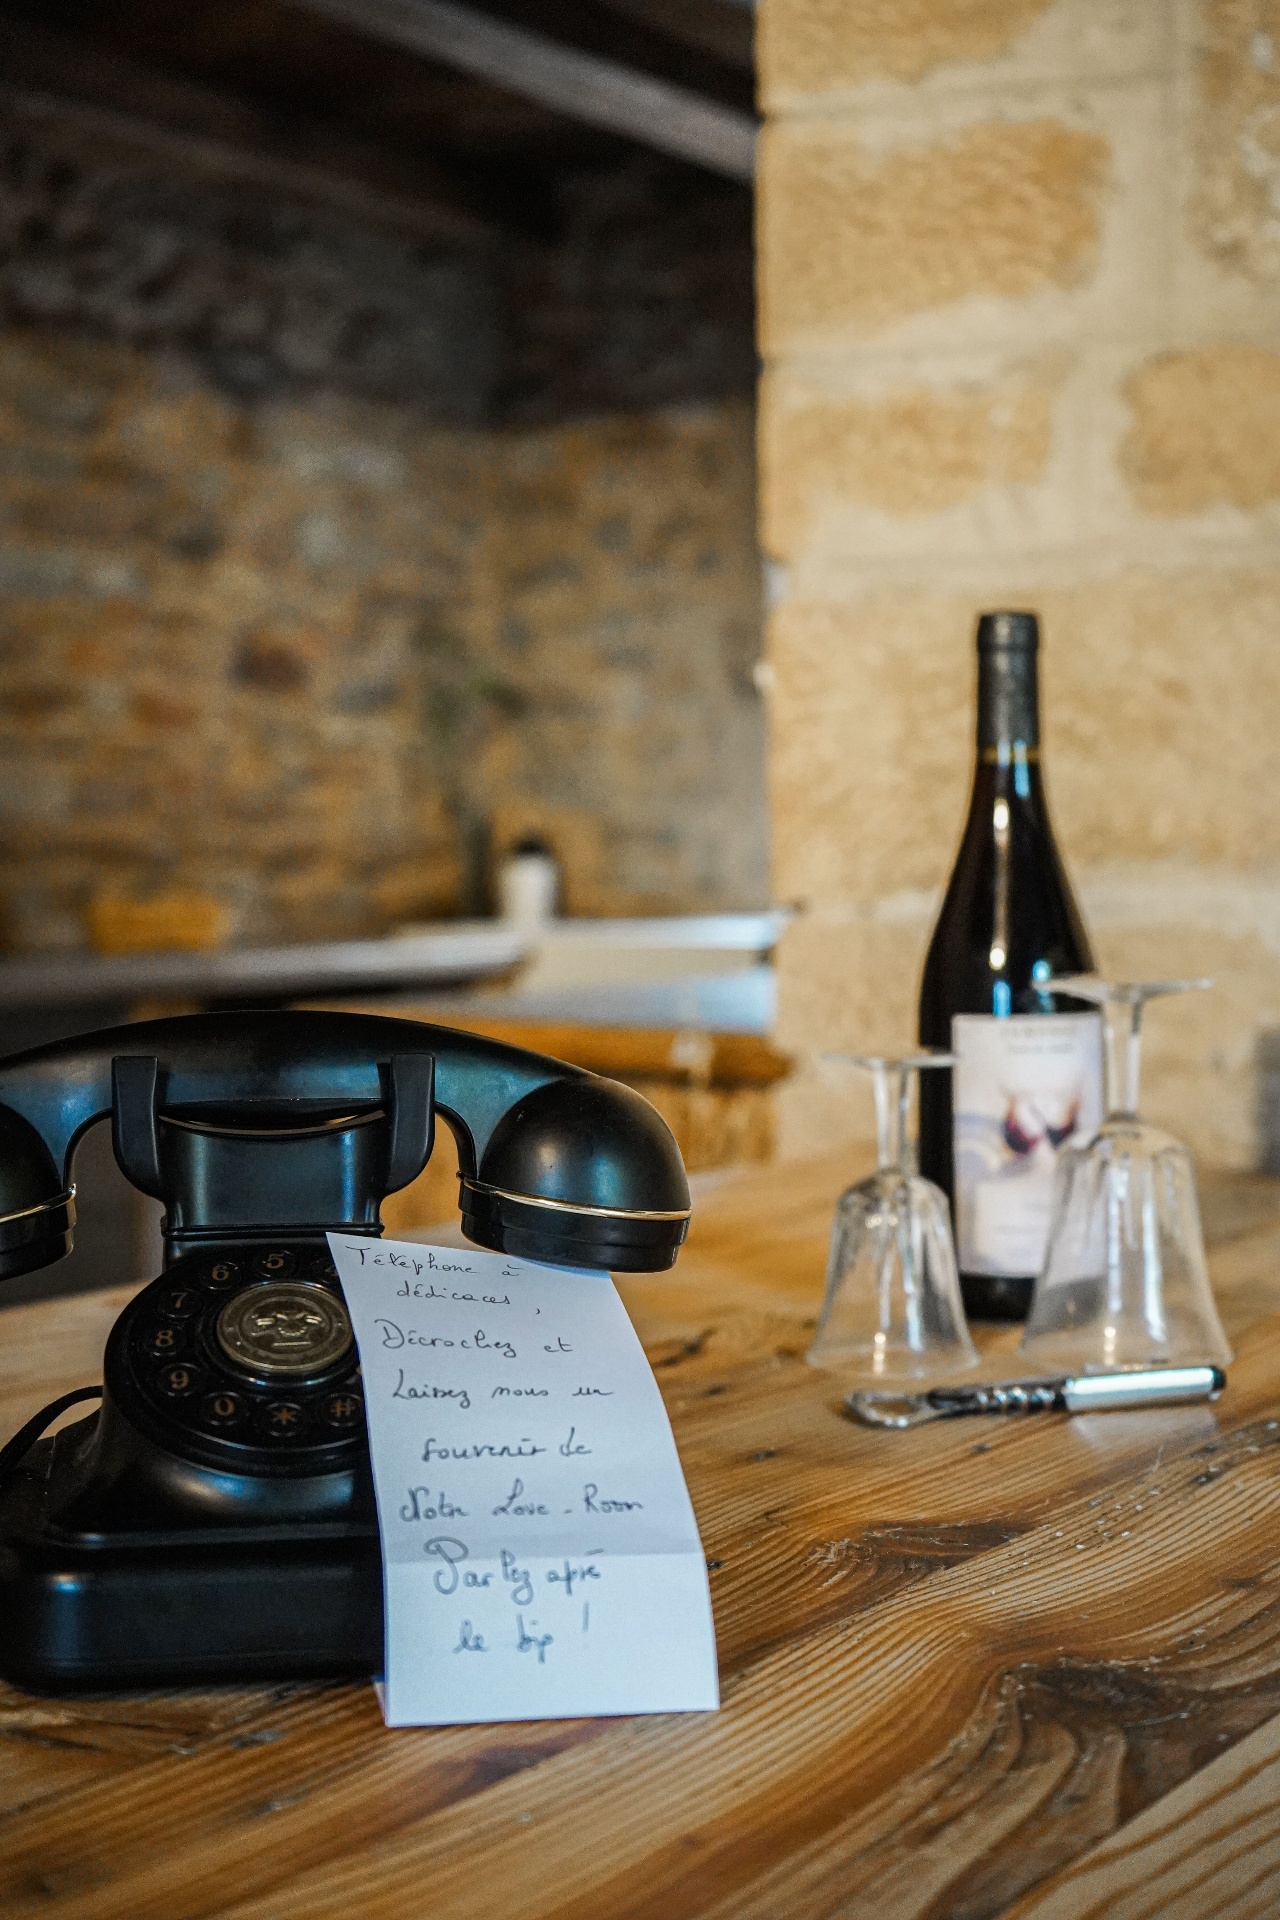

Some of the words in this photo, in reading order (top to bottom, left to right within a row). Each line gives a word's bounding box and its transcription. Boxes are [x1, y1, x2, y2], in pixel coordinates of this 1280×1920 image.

[265, 1253, 284, 1269] 5
[211, 1266, 230, 1281] 6
[171, 1292, 187, 1308] 7
[155, 1331, 174, 1348] 8
[374, 1319, 517, 1358] Décrochez
[544, 1337, 573, 1352] et
[170, 1371, 189, 1389] 9
[491, 1386, 549, 1399] nous
[572, 1388, 614, 1396] un
[215, 1399, 235, 1416] 0
[559, 1427, 592, 1455] de
[492, 1478, 549, 1516] Love
[584, 1483, 643, 1514] Room
